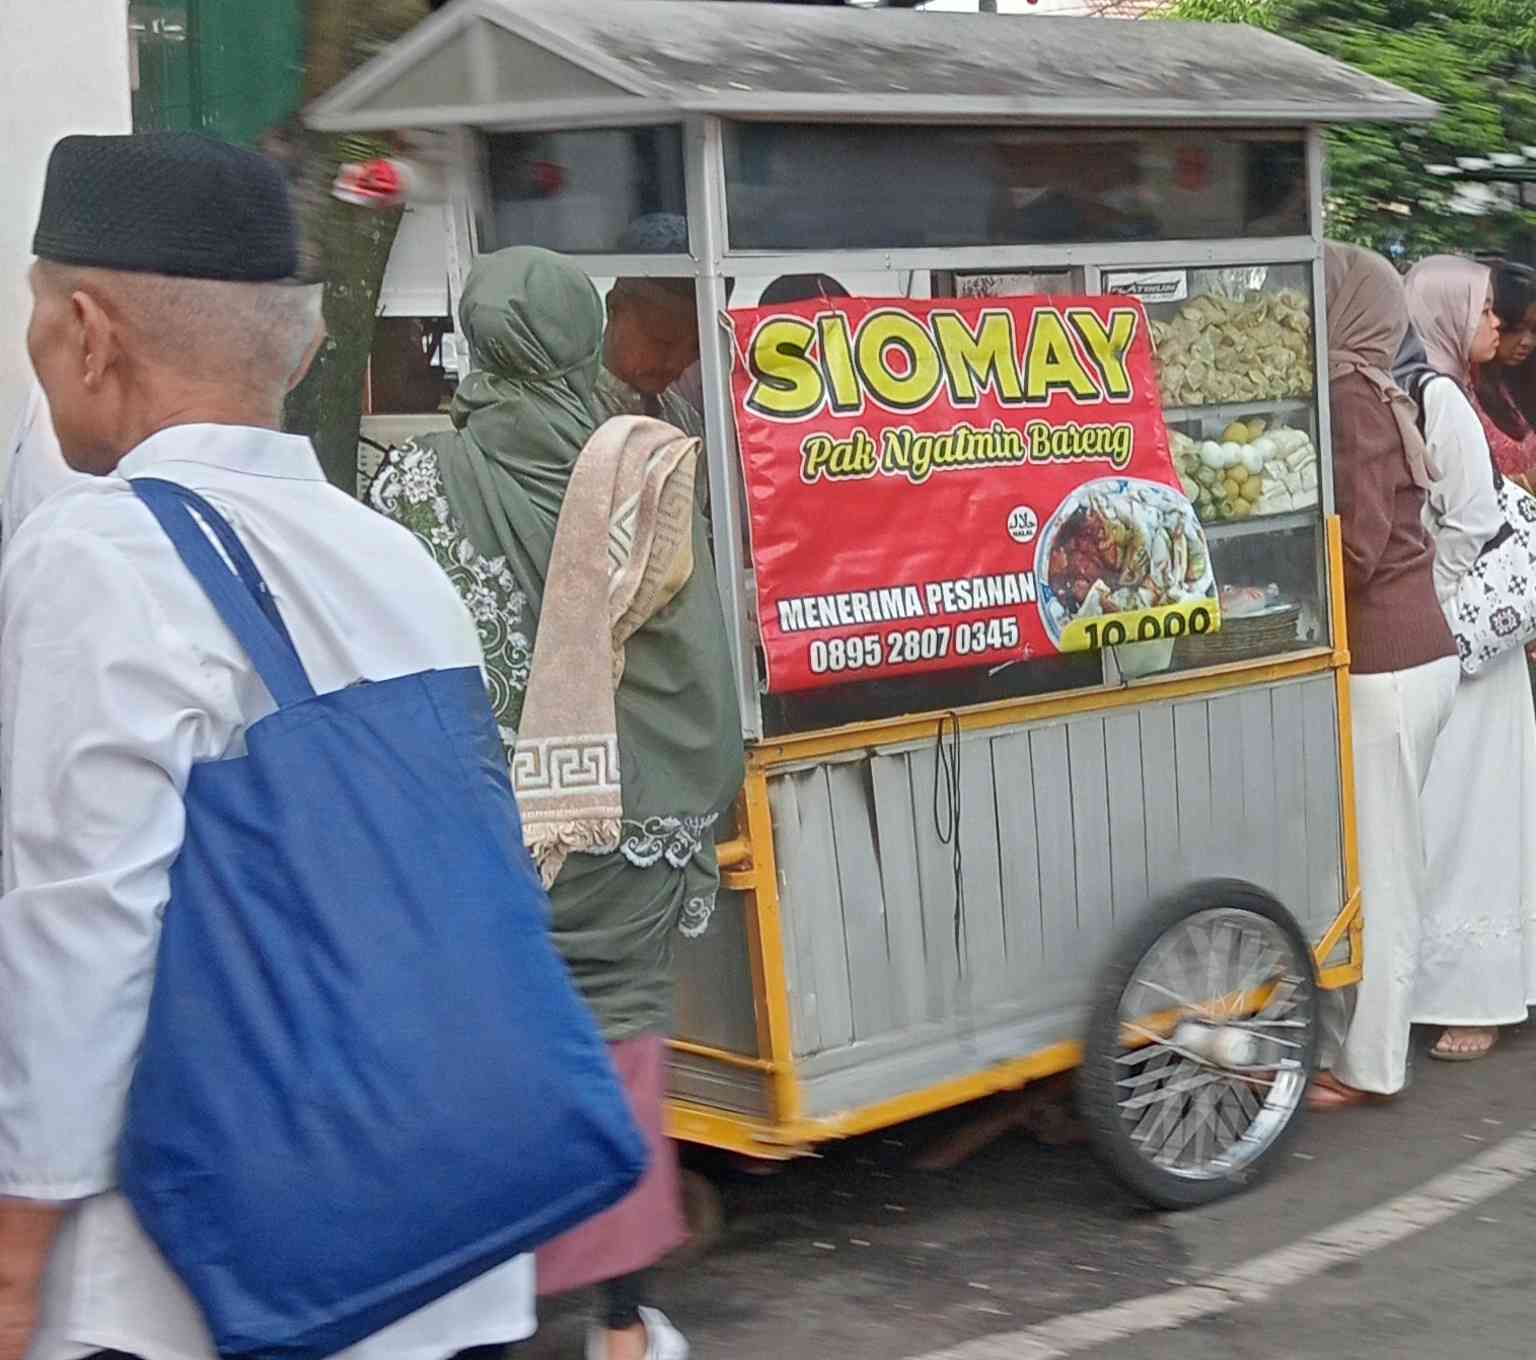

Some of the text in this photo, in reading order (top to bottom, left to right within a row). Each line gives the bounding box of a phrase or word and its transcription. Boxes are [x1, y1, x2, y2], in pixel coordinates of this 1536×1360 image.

[747, 308, 1138, 416] SIOMAY
[804, 421, 1133, 481] Pak Ngatmin Bareng
[778, 572, 1036, 631] MENERIMA PESANAN
[810, 617, 1018, 673] 0895 2807 0345
